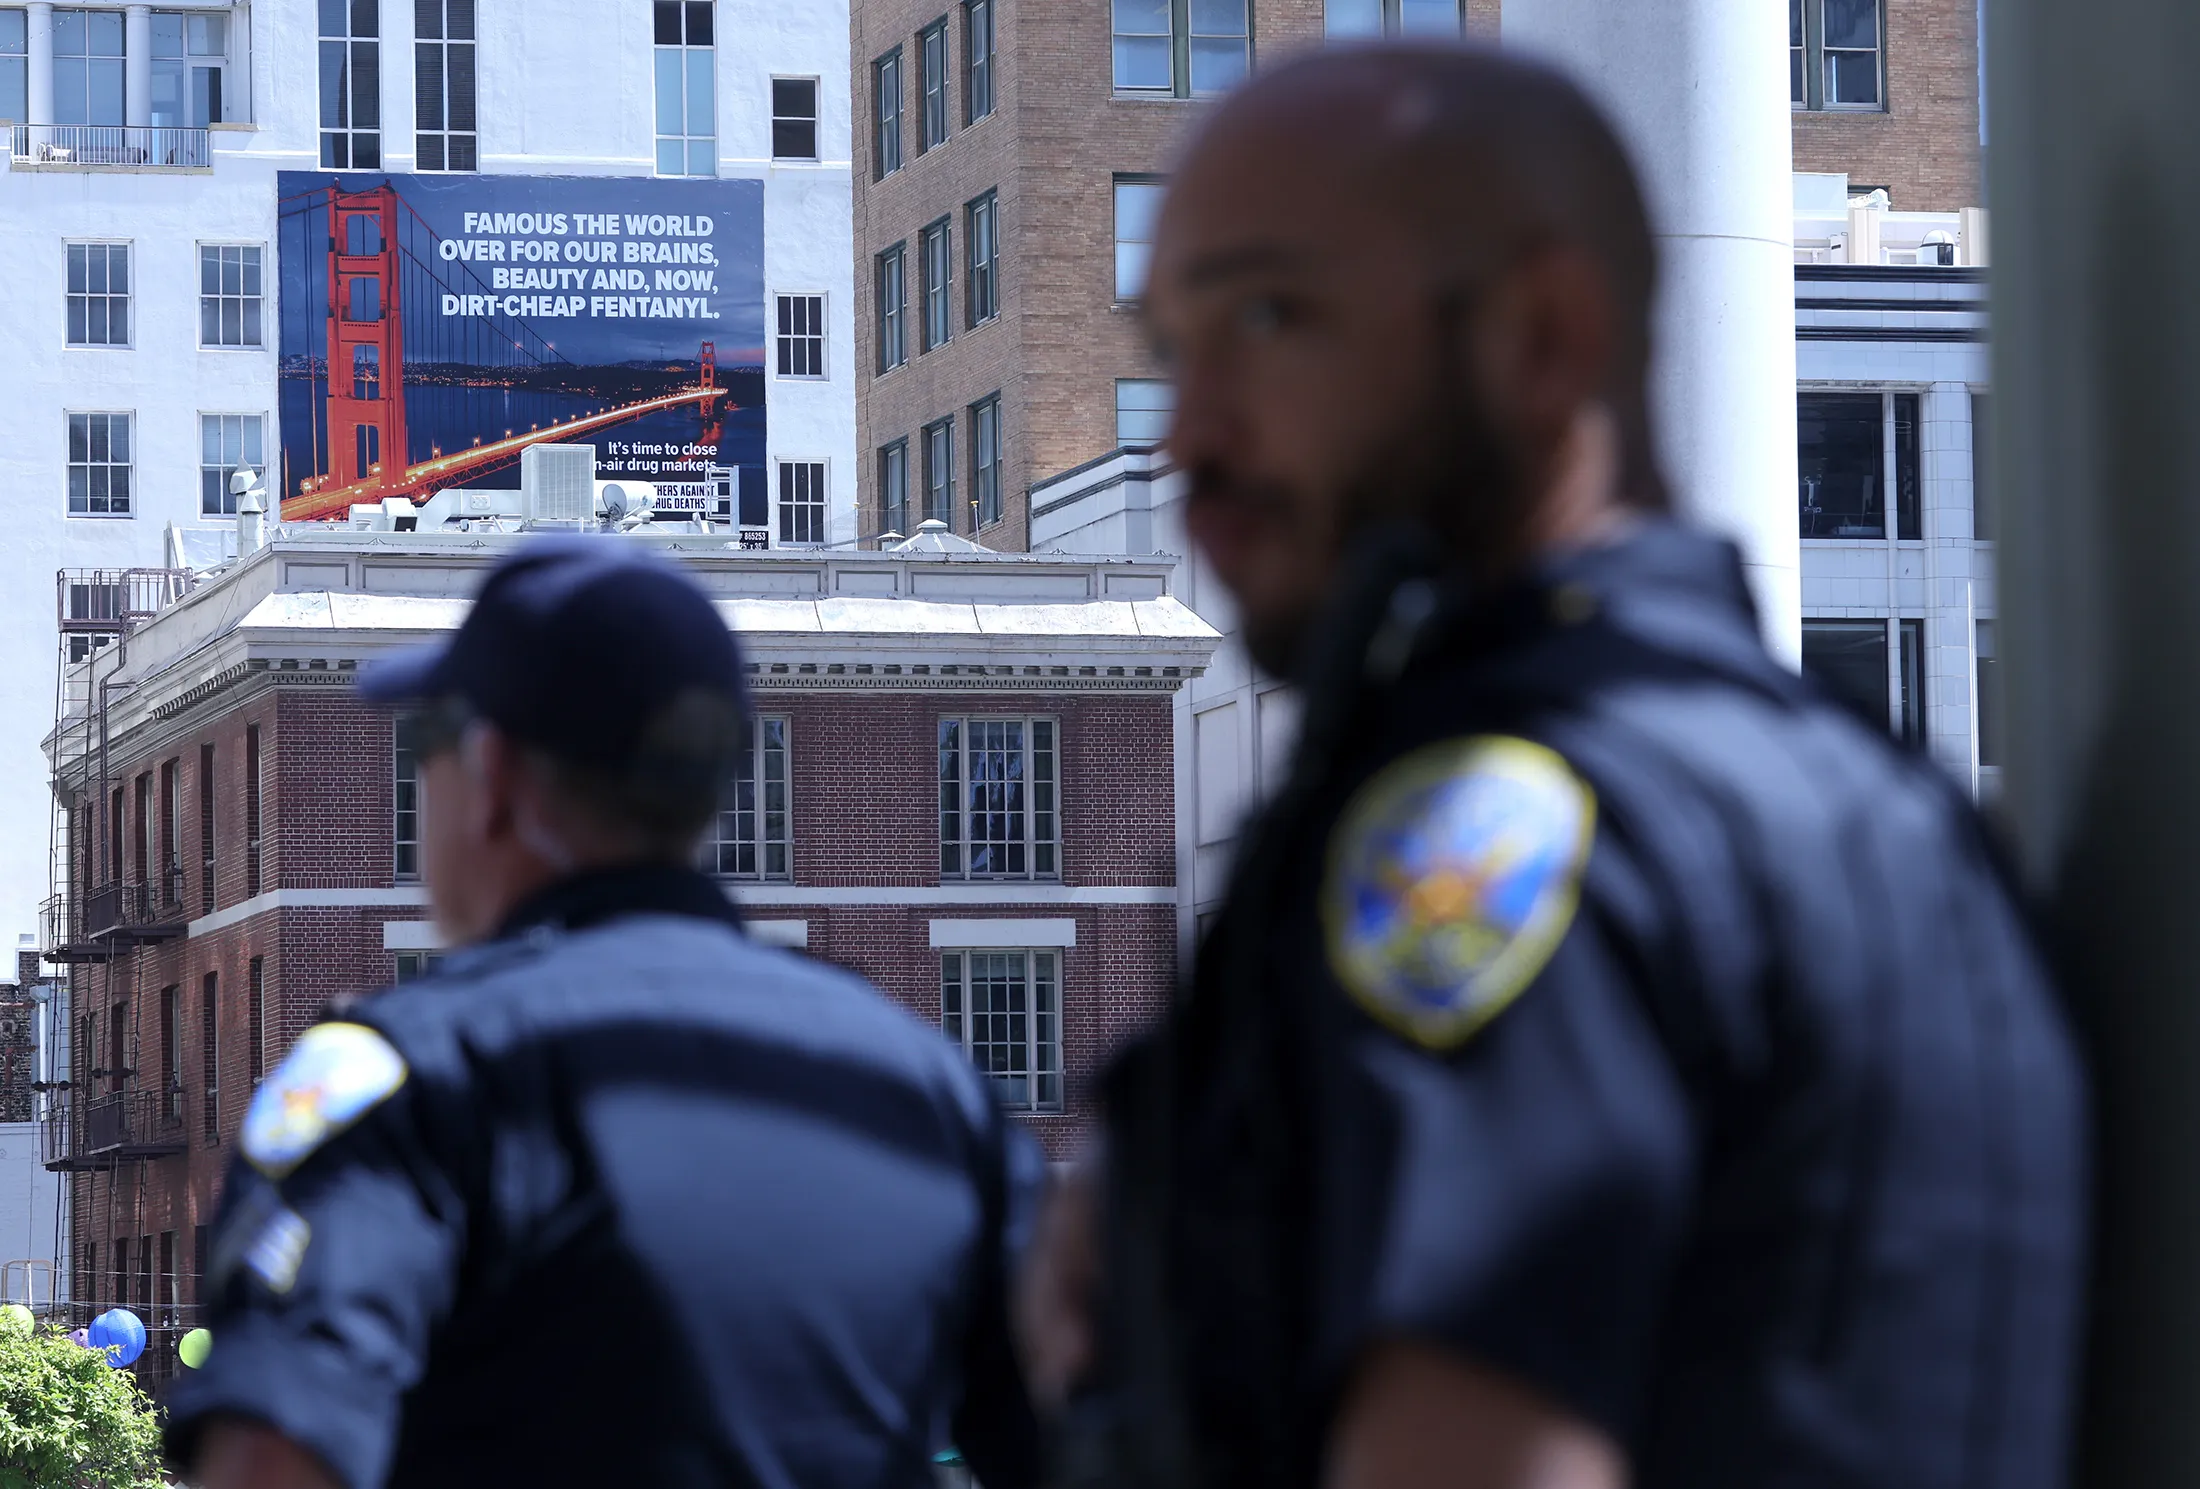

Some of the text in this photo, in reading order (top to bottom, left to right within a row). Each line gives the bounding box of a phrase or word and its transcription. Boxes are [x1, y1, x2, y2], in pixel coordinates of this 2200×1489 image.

[464, 212, 713, 236] FAMOUS THE WORLD
[439, 240, 719, 266] OVER FOR OUR BRAINS,
[493, 268, 718, 294] BEAUTY AND, NOW,
[442, 295, 720, 319] DIRT-CHEAP FENTANYL.
[608, 441, 717, 455] It's time to close
[627, 457, 659, 474] drug
[653, 484, 678, 496] HERS
[652, 497, 705, 509] RUG DEATHS
[744, 531, 766, 541] 865253
